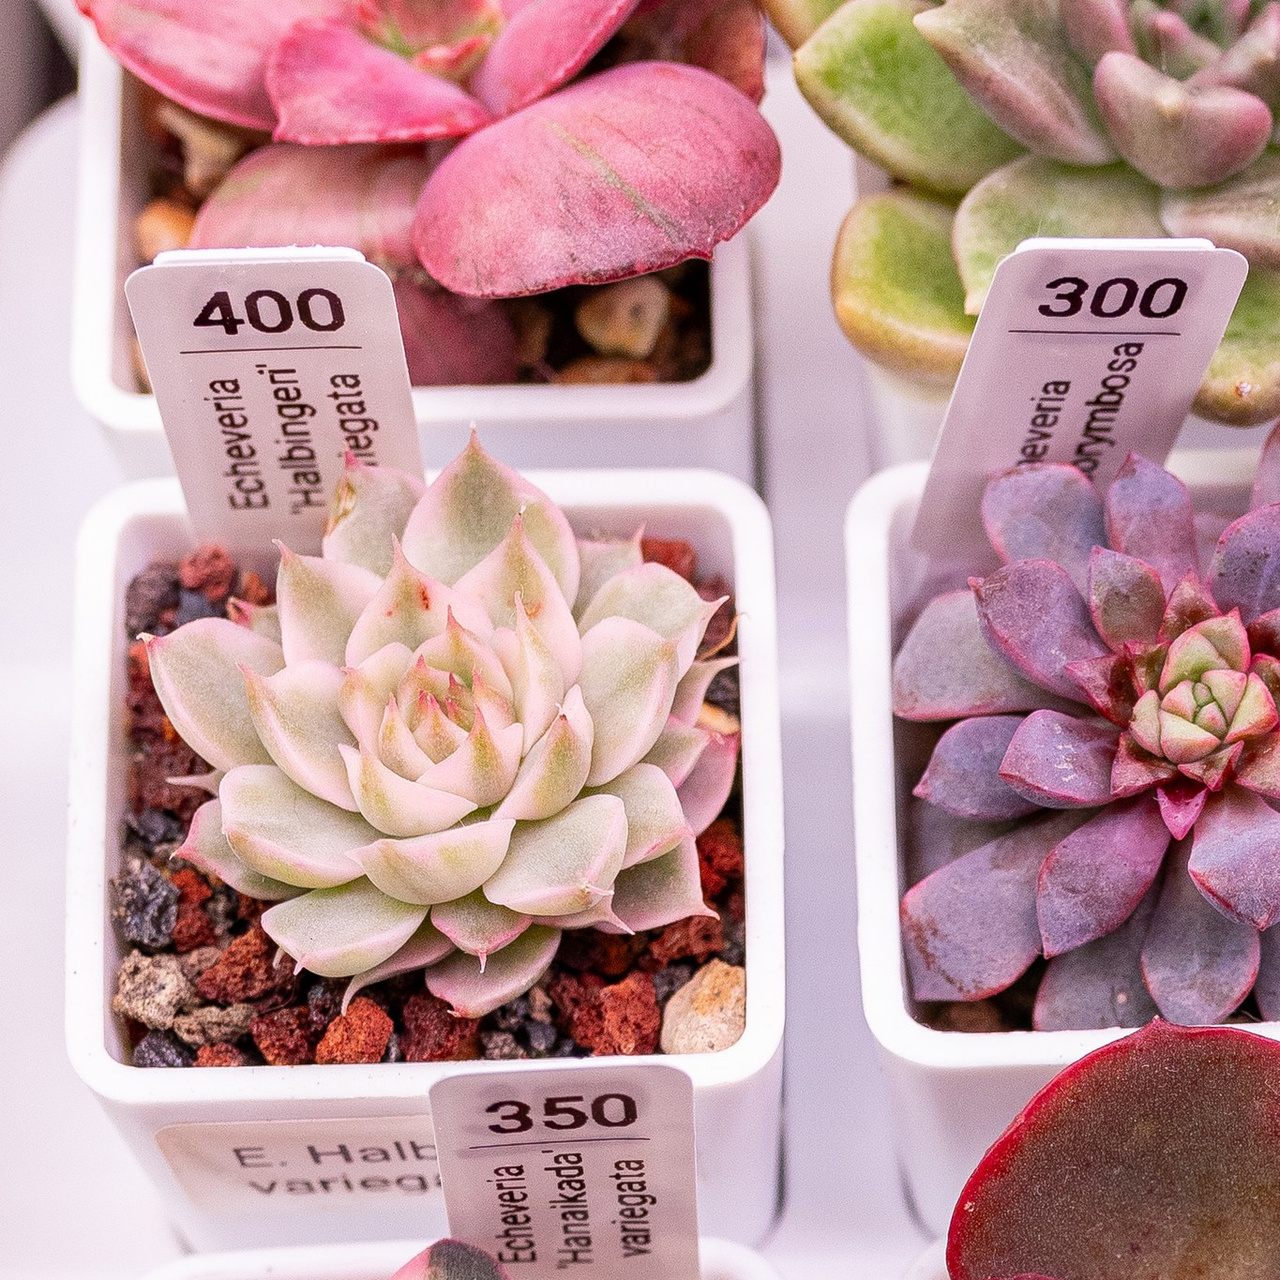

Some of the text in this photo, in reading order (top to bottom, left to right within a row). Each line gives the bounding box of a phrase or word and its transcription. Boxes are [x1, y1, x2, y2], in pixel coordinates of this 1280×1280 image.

[193, 288, 346, 335] 400
[1038, 277, 1188, 318] 300
[204, 378, 269, 511] Echeveria
[327, 374, 380, 467] iegata
[1017, 381, 1071, 466] everia
[1074, 342, 1144, 478] orymbosa
[485, 1093, 638, 1134] 350
[249, 1174, 442, 1195] varieg
[486, 1164, 537, 1264] Echeveria
[608, 1159, 657, 1258] variegata
